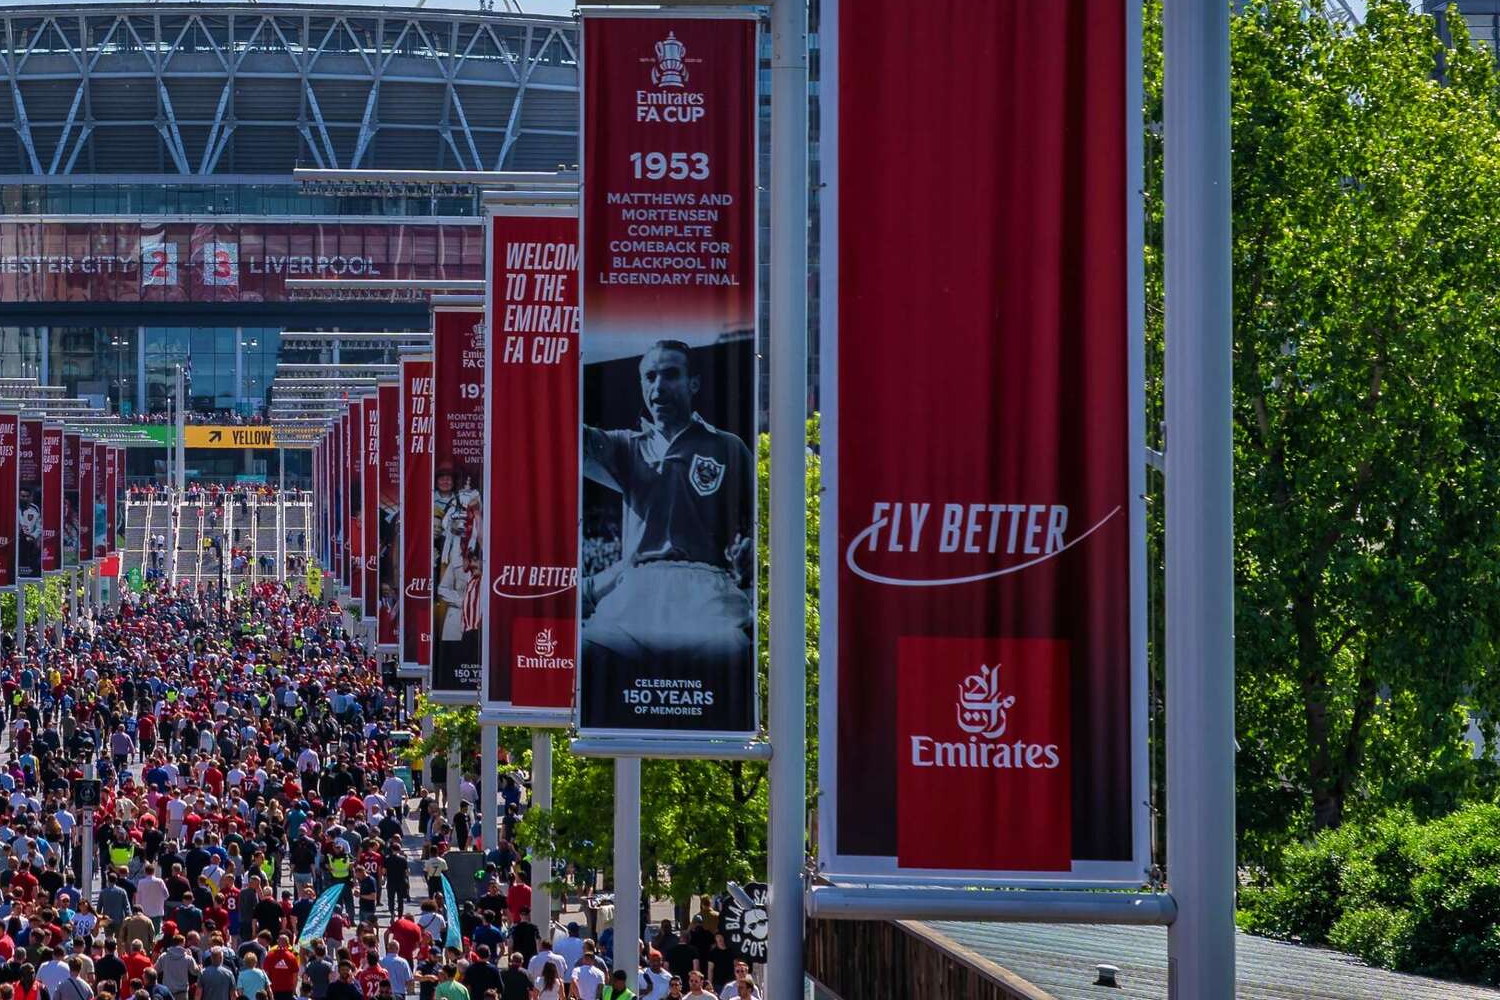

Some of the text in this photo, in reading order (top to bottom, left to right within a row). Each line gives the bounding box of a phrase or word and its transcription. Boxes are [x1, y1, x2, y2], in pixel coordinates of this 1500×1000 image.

[636, 90, 704, 104] Emirates
[636, 107, 705, 122] FA CUP
[629, 152, 709, 180] 1953
[607, 193, 732, 206] MATTHEWS AND
[622, 209, 718, 221] MORTENSEN
[628, 225, 712, 237] COMPLETE
[610, 241, 730, 254] COMEBACK FOR
[506, 243, 580, 270] WELCOM
[612, 257, 727, 269] BLACKPOOL IN
[81, 256, 135, 272] CITY
[151, 251, 168, 277] 2
[212, 251, 232, 278] 3
[249, 256, 380, 275] LIVERPOOL
[600, 273, 740, 286] LEGENDARY FINAL
[506, 274, 567, 301] TO THE
[504, 305, 580, 333] EMIRATE
[504, 336, 569, 364] FA CUP
[463, 360, 475, 368] FA
[460, 384, 484, 398] 19
[412, 397, 424, 414] TO
[233, 431, 272, 445] YELLOW
[411, 436, 423, 453] FA
[869, 502, 1069, 554] FLY BETTER
[501, 566, 577, 586] FLY BETTER
[411, 578, 425, 591] FLY
[517, 655, 574, 668] Emirates
[635, 679, 702, 688] CELEBRATING
[622, 689, 714, 705] 150 YEARS
[634, 706, 702, 715] OF MEMORIES
[910, 735, 1060, 768] Emirates
[228, 897, 236, 910] 8
